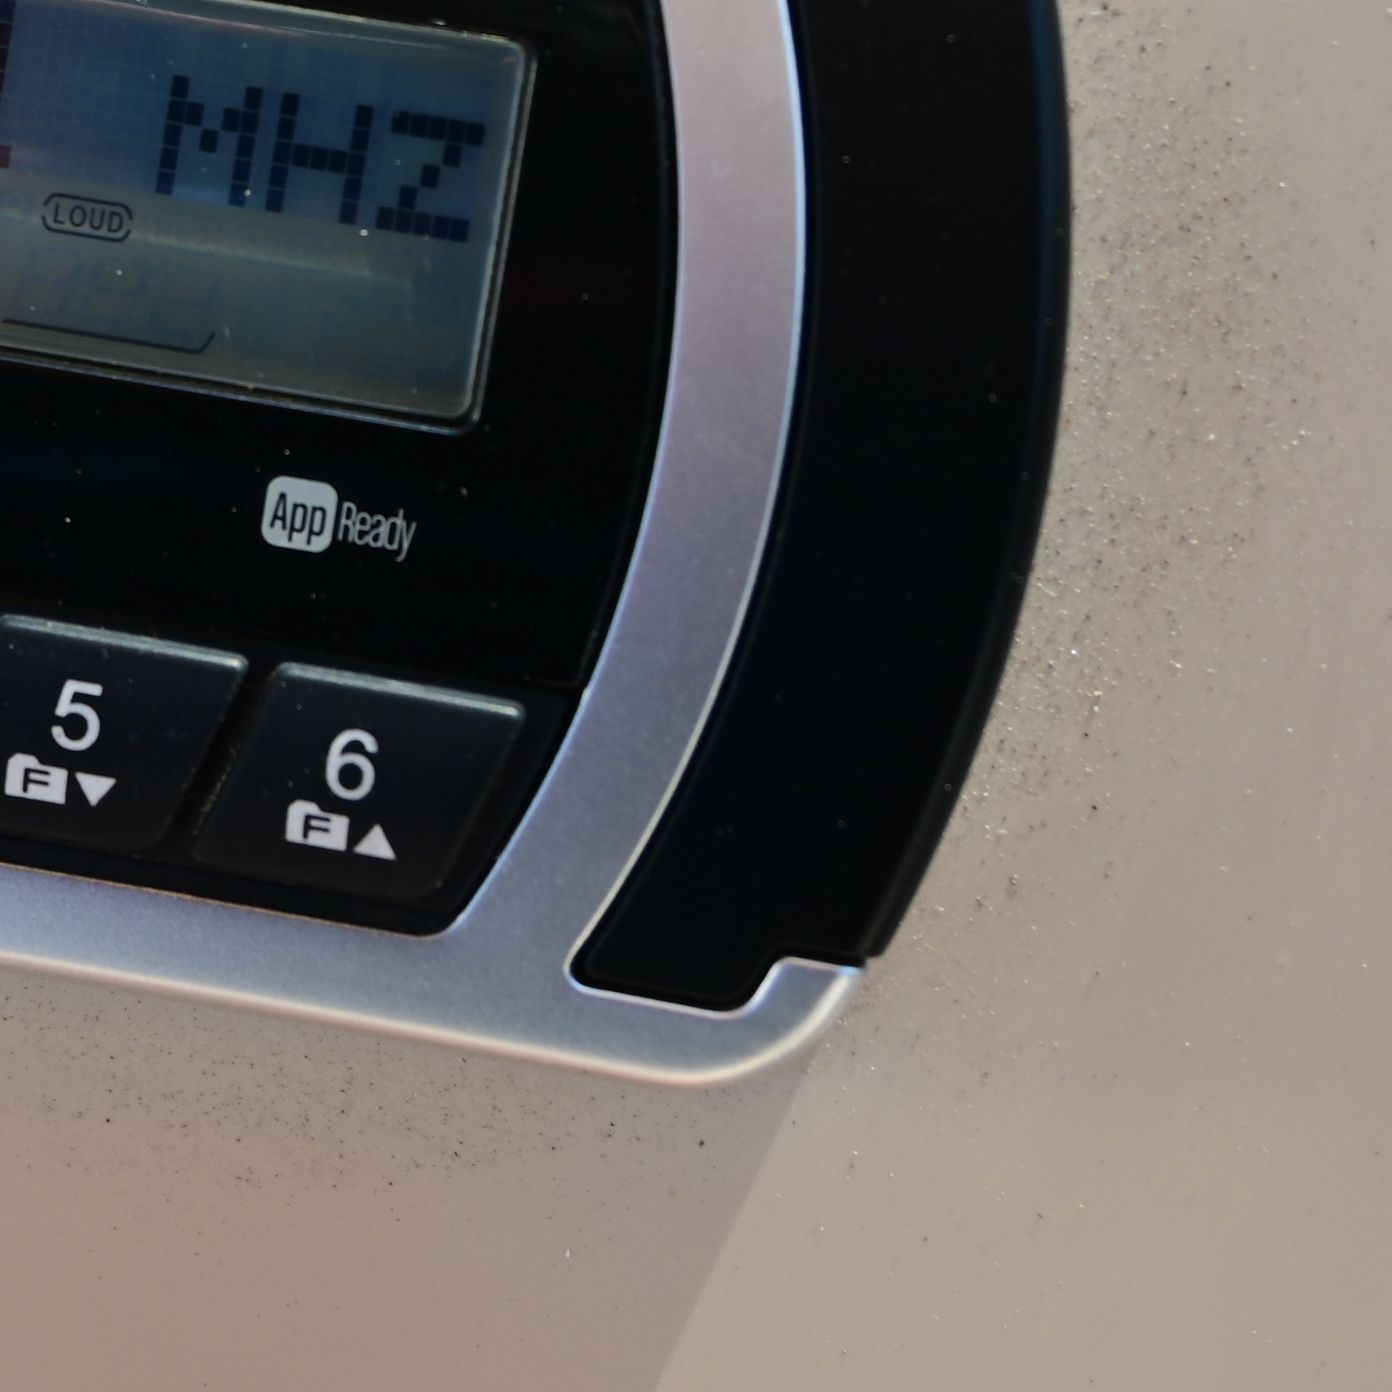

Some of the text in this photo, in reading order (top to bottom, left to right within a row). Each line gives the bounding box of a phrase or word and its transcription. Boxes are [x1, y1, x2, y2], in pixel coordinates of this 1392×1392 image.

[154, 74, 487, 244] MHZ
[52, 202, 127, 235] LOUD
[269, 491, 417, 562] App Ready
[52, 680, 102, 750] 5
[326, 729, 377, 800] 6
